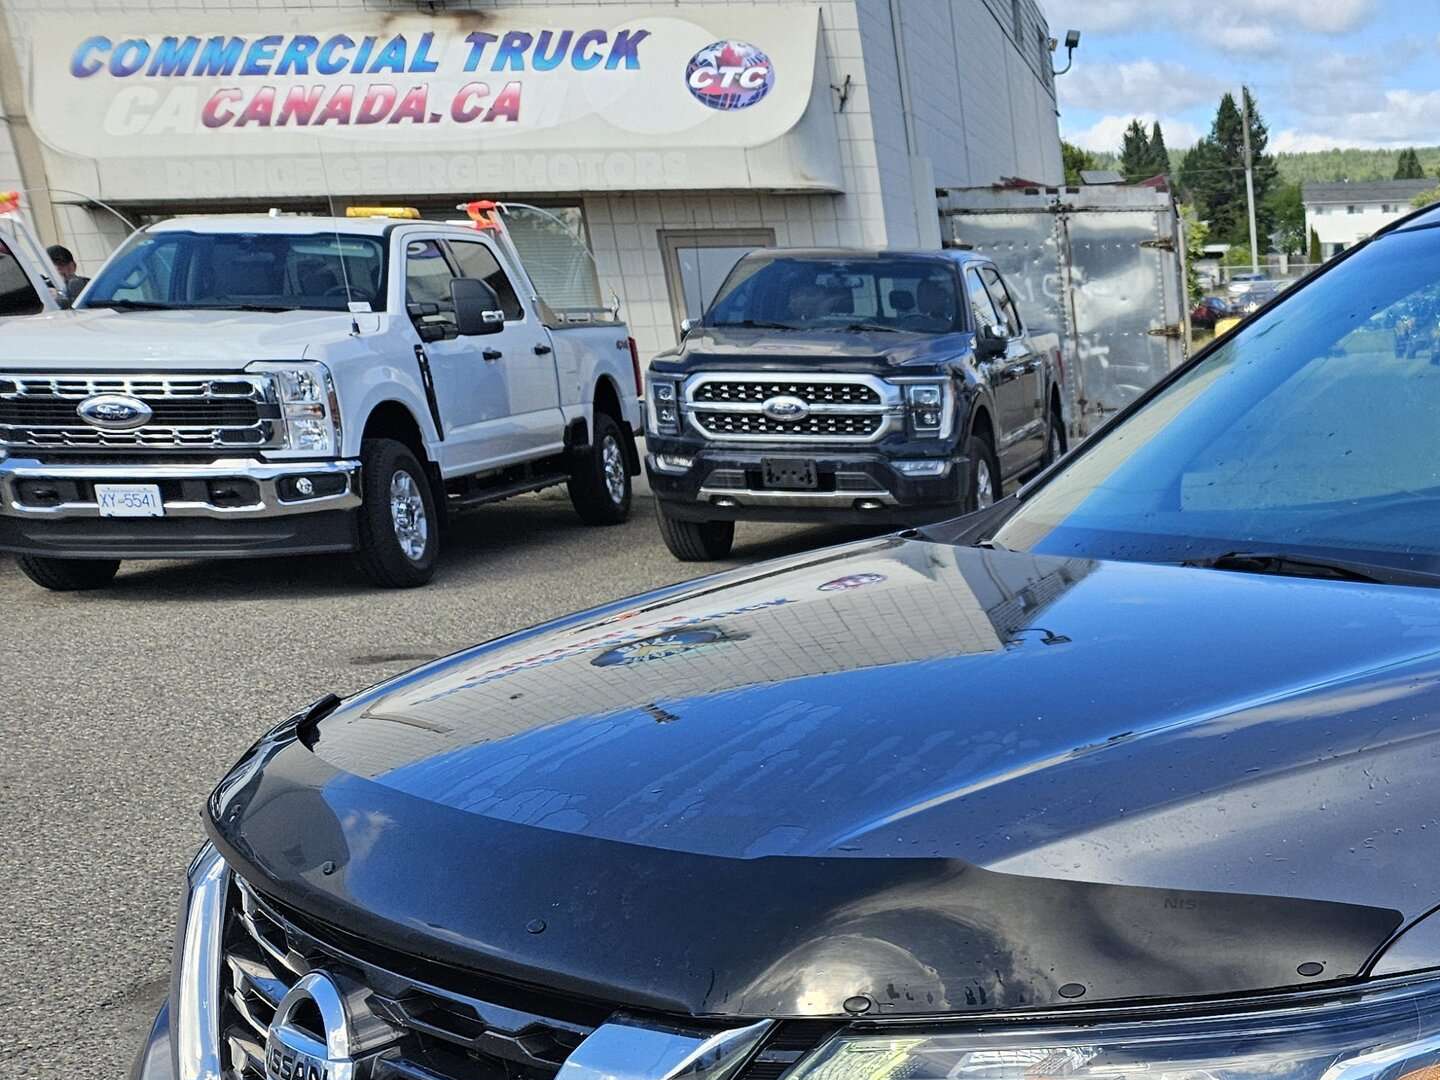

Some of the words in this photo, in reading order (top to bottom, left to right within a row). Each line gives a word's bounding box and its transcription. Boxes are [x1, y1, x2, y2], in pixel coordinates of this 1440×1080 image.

[70, 31, 440, 78] COMMERCIAL
[463, 29, 652, 73] TRUCK
[689, 66, 768, 89] CTC
[201, 81, 523, 128] CANADA.CA
